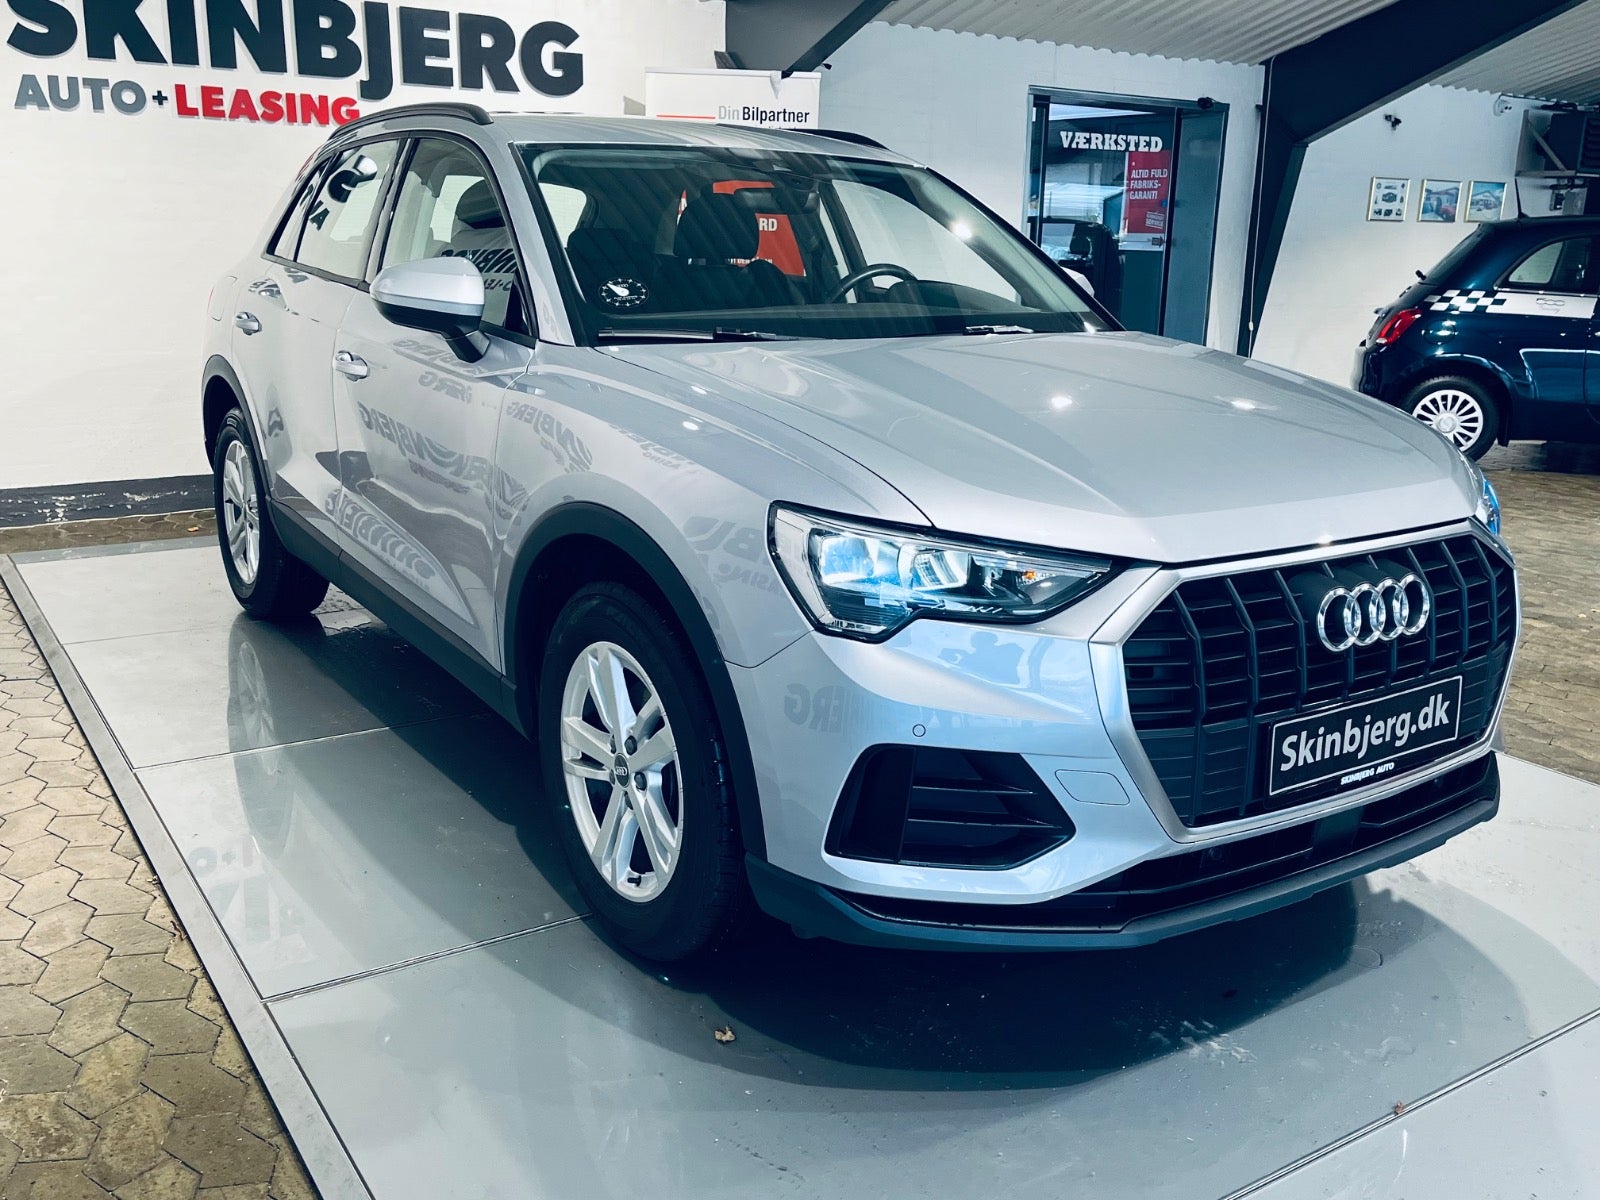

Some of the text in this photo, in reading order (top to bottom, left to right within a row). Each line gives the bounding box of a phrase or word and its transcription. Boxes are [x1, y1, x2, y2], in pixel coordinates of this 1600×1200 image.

[7, 0, 583, 100] SKINBJERG
[15, 74, 147, 114] AUTO
[174, 84, 360, 125] LEASING
[718, 105, 810, 124] Din Bilpartner
[1060, 131, 1163, 152] VÆRKSTED
[1131, 169, 1168, 178] ALTID FULD
[1130, 190, 1158, 200] GARANTI
[759, 218, 778, 231] RD
[1280, 693, 1450, 771] Skinbjerg.dk
[1375, 762, 1395, 774] AUTO
